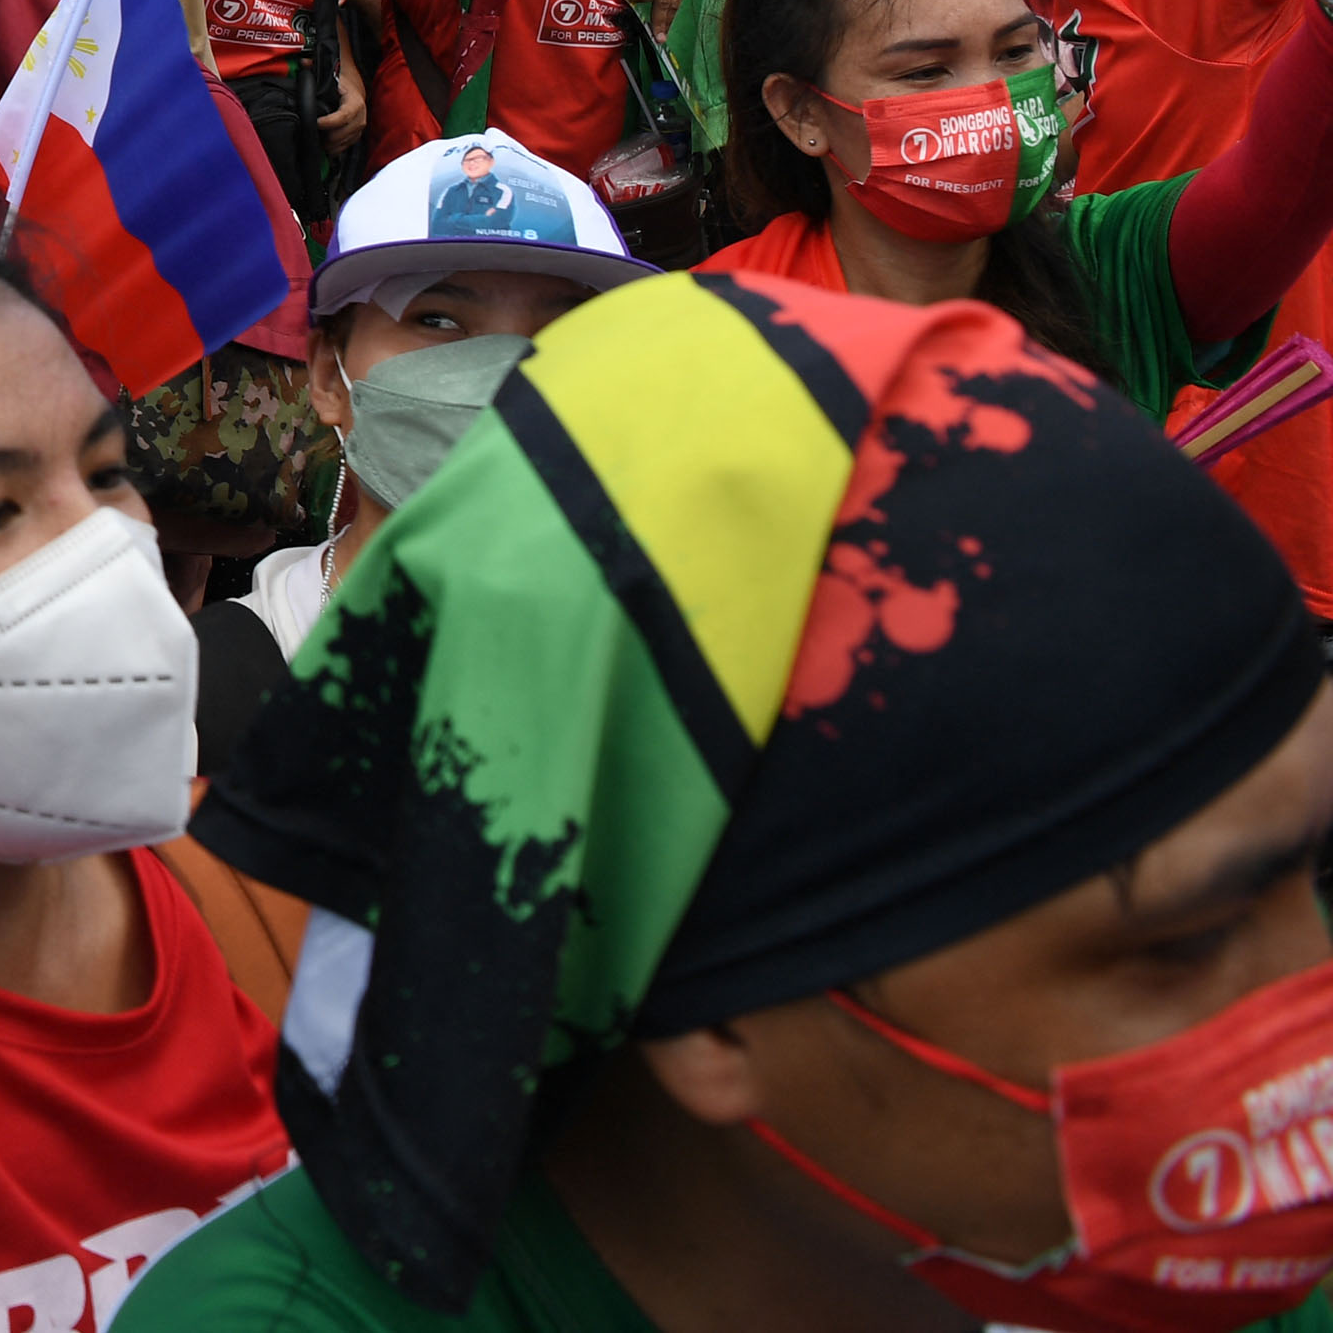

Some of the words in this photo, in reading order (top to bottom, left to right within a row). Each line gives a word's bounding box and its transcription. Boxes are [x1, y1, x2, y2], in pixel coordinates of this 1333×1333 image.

[208, 24, 231, 37] FOR
[236, 29, 301, 43] PRESIDENT
[550, 29, 572, 41] FOR
[1015, 96, 1045, 118] SARA
[939, 105, 1012, 137] BONGBONG
[942, 126, 1014, 158] MARCOS
[904, 173, 931, 188] FOR
[935, 178, 1005, 194] PRESIDENT
[1018, 176, 1040, 189] FOR
[476, 228, 521, 238] NUMBER
[523, 228, 539, 241] 8
